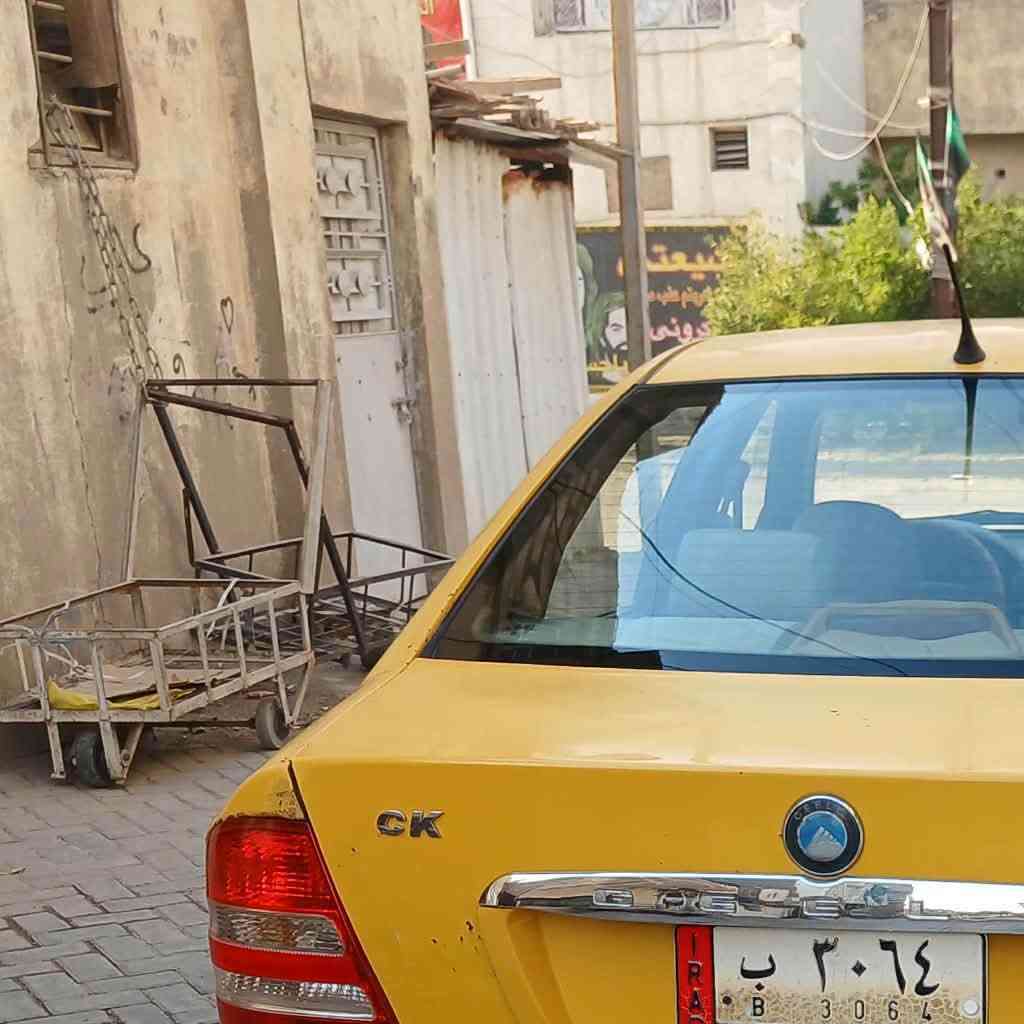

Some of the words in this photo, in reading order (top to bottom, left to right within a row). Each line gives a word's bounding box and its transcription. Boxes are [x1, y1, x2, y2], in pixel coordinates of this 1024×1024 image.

[376, 808, 445, 838] CK
[739, 952, 777, 991] ب
[751, 995, 765, 1018] B
[820, 998, 933, 1022] 3064
